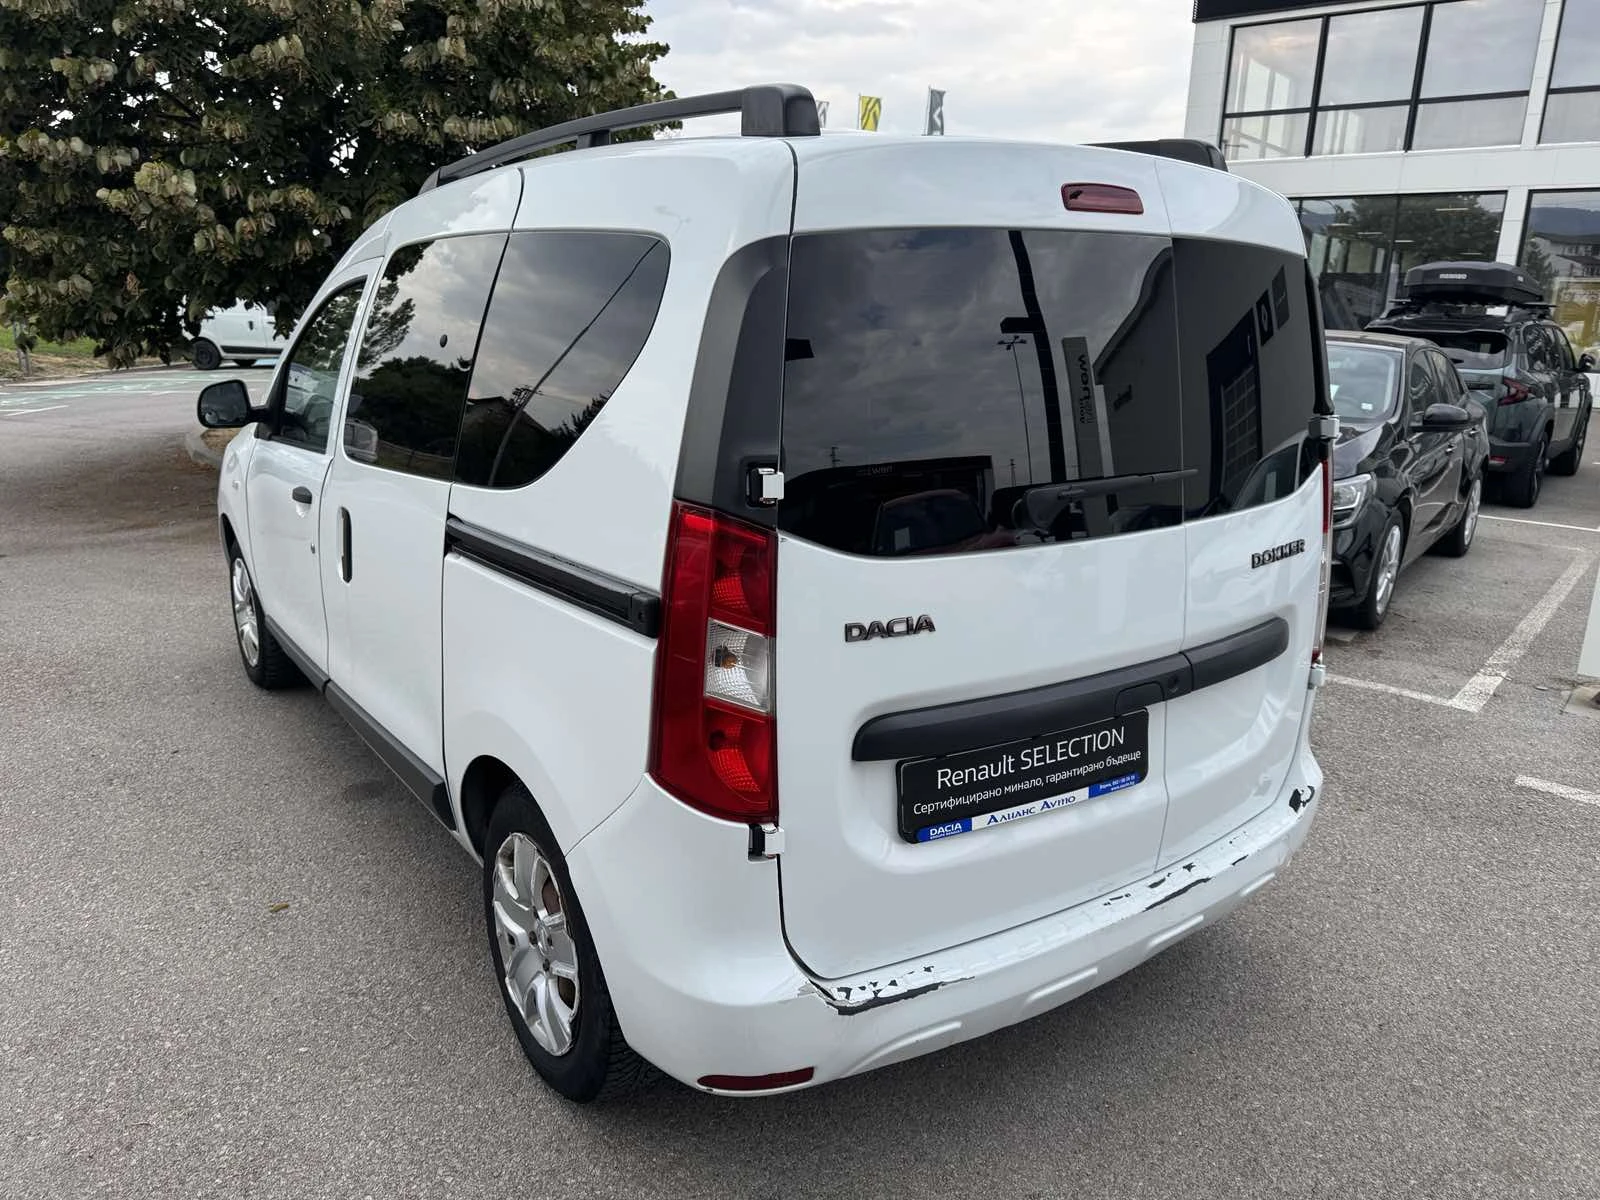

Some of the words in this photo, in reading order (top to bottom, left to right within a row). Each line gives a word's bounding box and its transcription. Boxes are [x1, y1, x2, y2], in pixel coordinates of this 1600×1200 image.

[1251, 538, 1305, 569] DOKKER
[844, 614, 936, 643] DACIA
[937, 754, 1016, 790] Renault
[1020, 725, 1125, 771] SELECTION
[913, 787, 1002, 815] Сертифицирано
[1004, 777, 1045, 795] минало,
[1045, 761, 1105, 784] гарантирано
[1106, 750, 1142, 767] бъдеще
[929, 822, 962, 836] DACIA
